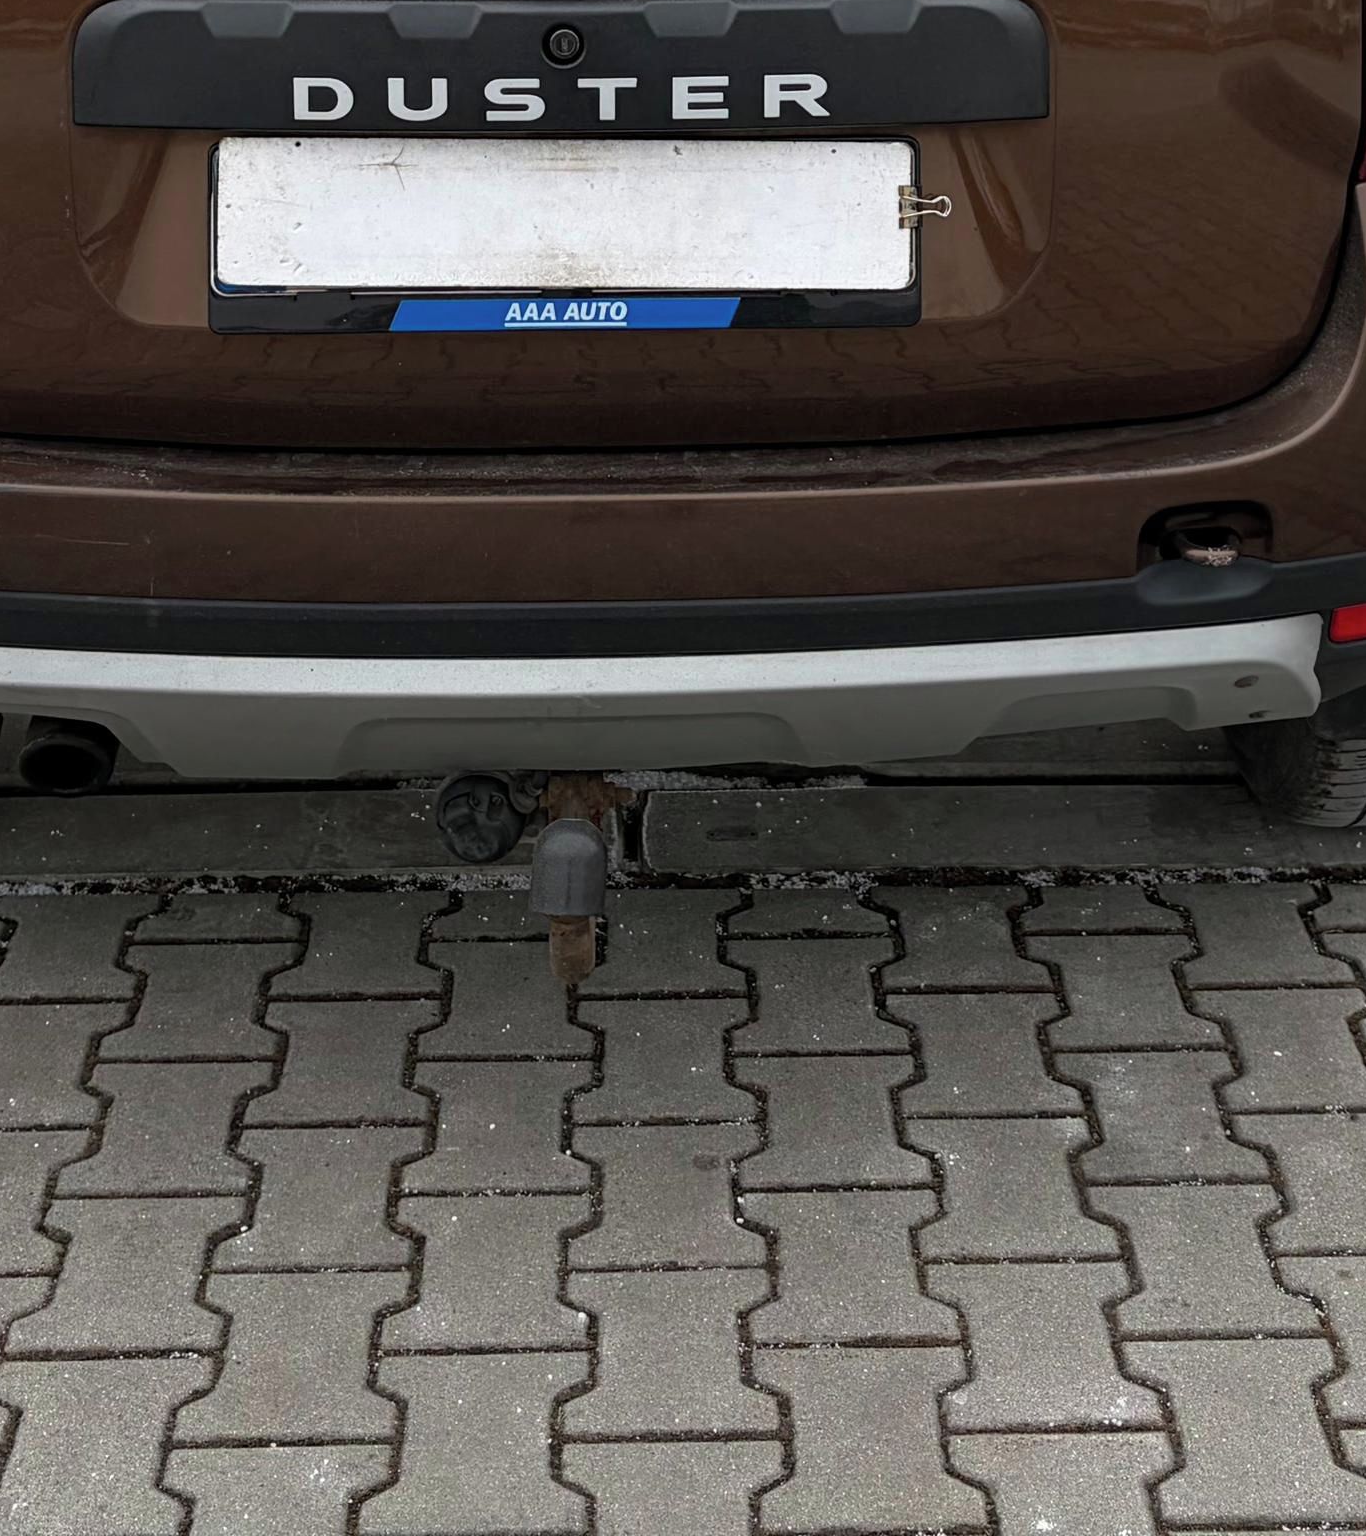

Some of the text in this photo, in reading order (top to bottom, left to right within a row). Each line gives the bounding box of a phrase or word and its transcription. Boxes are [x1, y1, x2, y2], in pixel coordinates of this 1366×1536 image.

[293, 74, 830, 121] DUSTER
[505, 301, 627, 322] AAA AUTO
